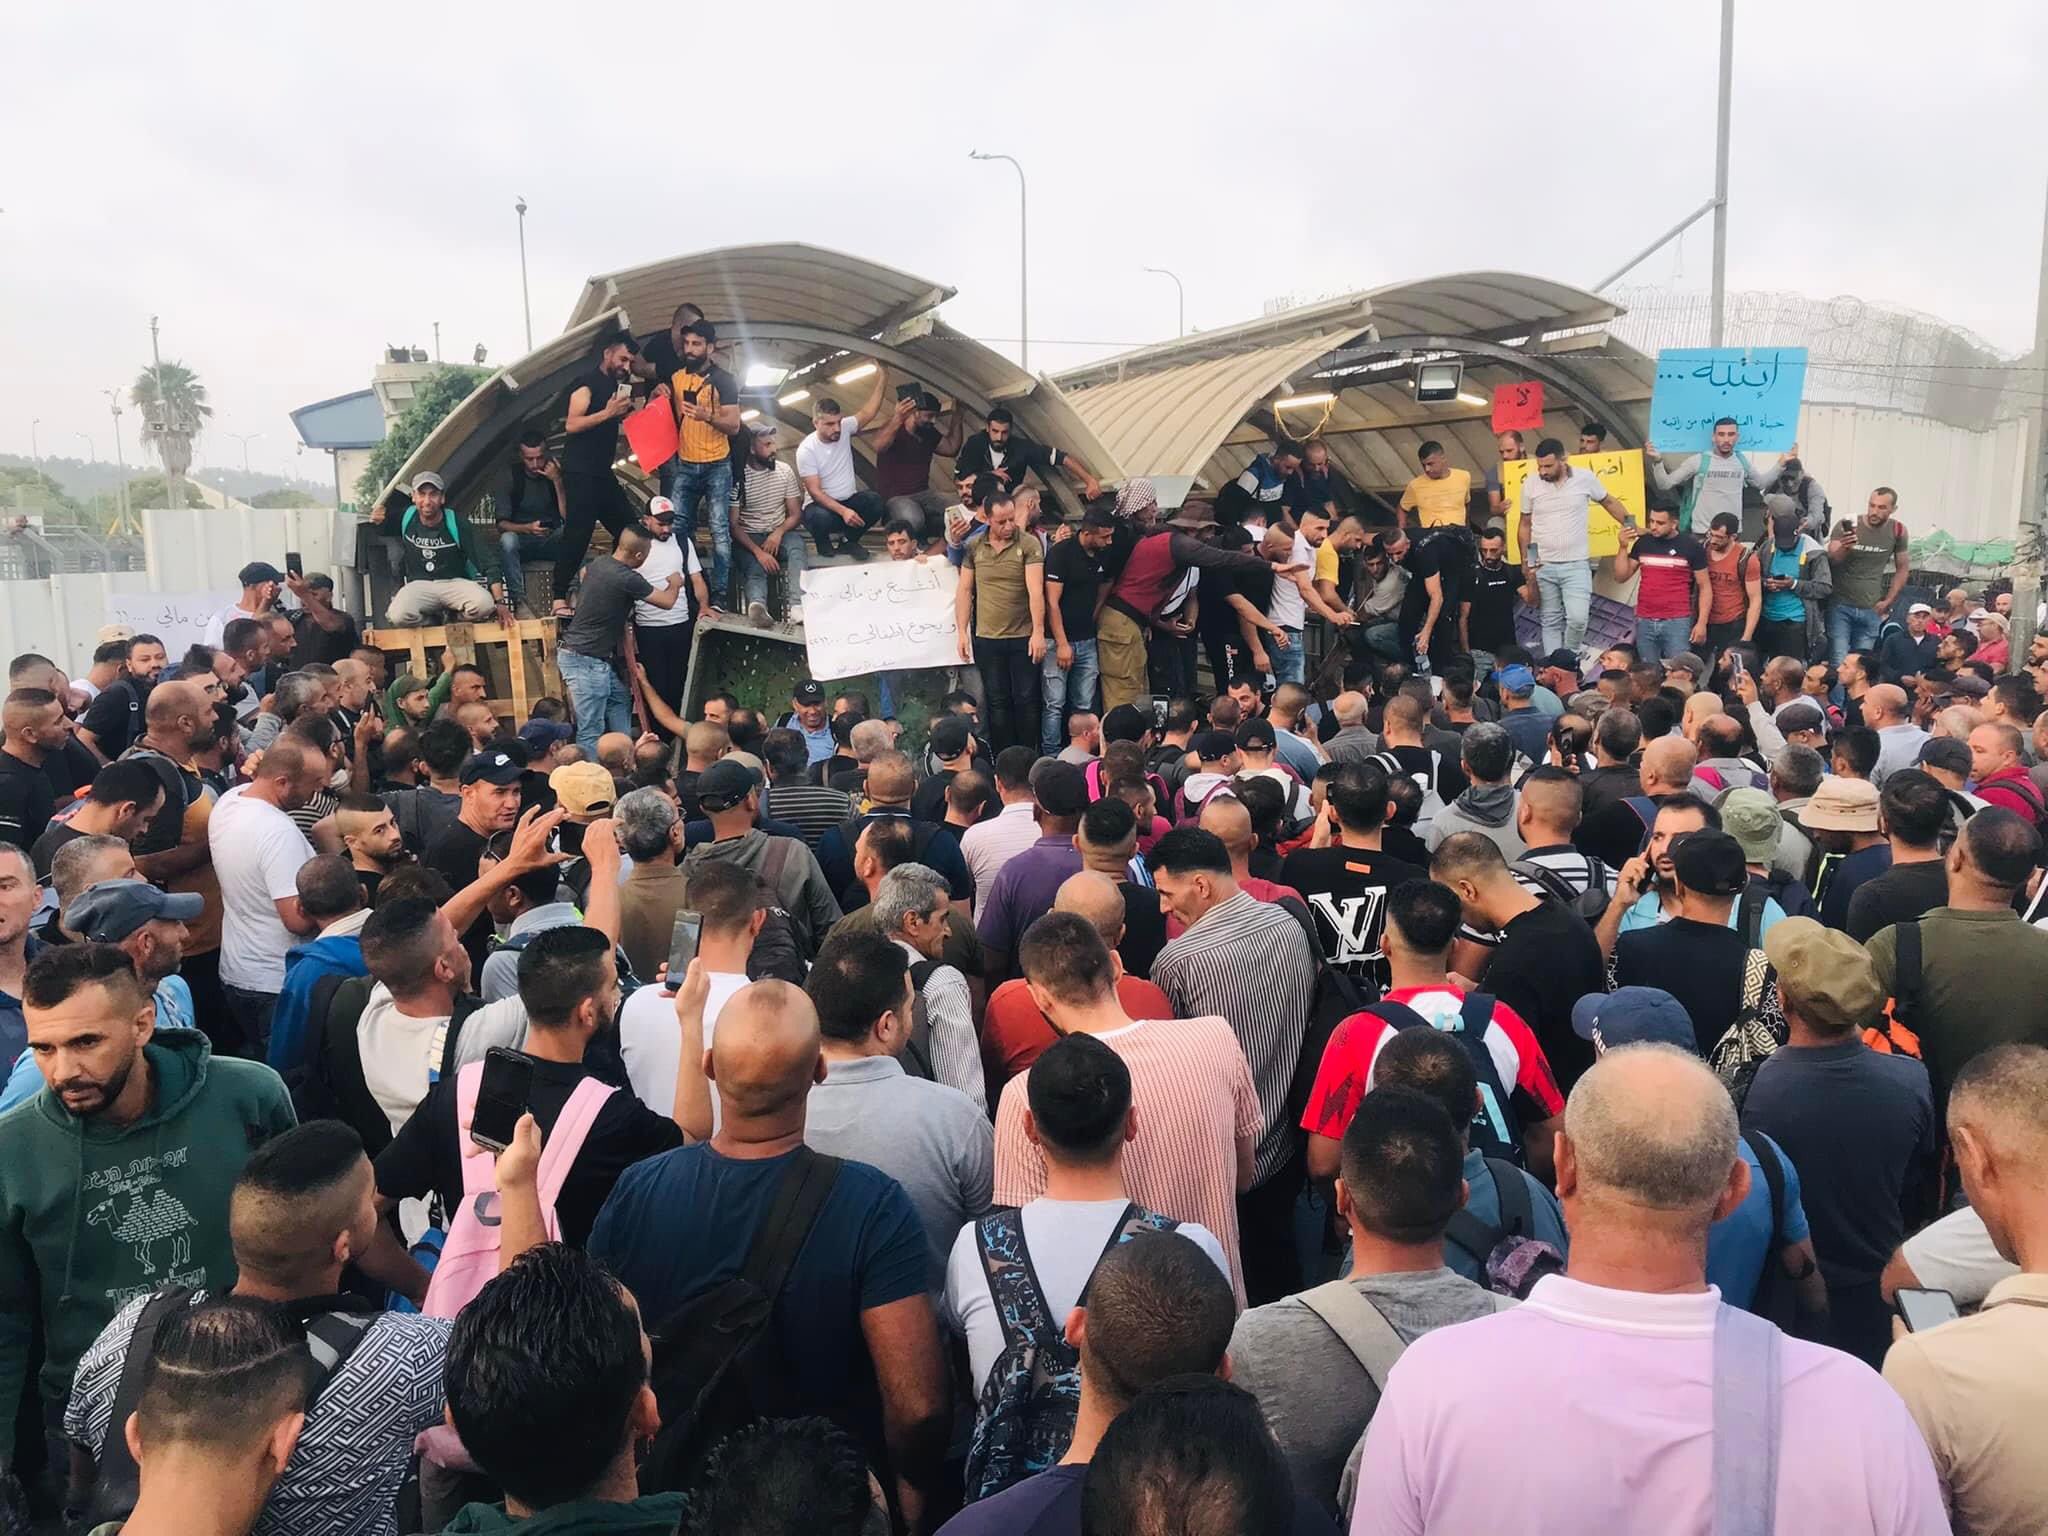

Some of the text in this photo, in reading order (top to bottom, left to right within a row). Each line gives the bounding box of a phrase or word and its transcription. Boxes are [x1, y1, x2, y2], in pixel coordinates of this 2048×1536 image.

[1685, 417, 1697, 430] من
[1700, 412, 1715, 429] أهم
[868, 587, 882, 601] من
[157, 605, 189, 628] مالي
